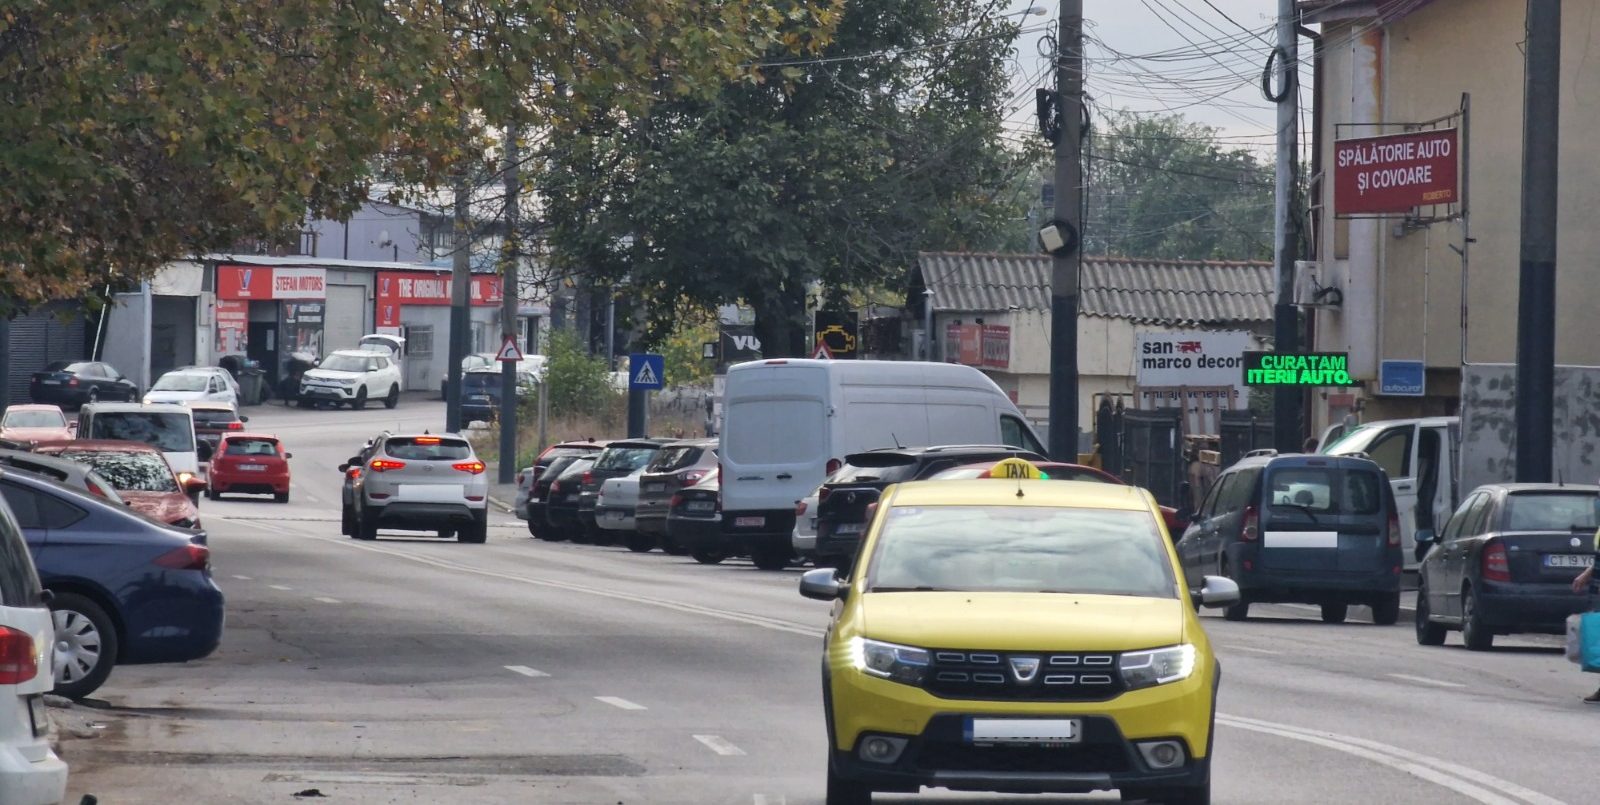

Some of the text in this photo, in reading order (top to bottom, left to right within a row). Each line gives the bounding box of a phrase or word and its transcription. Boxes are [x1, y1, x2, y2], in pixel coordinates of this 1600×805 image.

[1338, 139, 1451, 168] SPĂLĂTORIE AUTO
[1357, 165, 1432, 196] ȘI COVOARE
[1422, 189, 1451, 201] ROBERTO
[275, 276, 323, 291] STEFAN MOTORS
[398, 279, 412, 298] THE
[413, 279, 445, 298] ORIGINAL
[1142, 341, 1173, 354] san
[1143, 353, 1243, 369] marco decor
[1261, 355, 1346, 369] CURATAM
[1004, 462, 1030, 479] TAXI
[1551, 555, 1563, 566] CT
